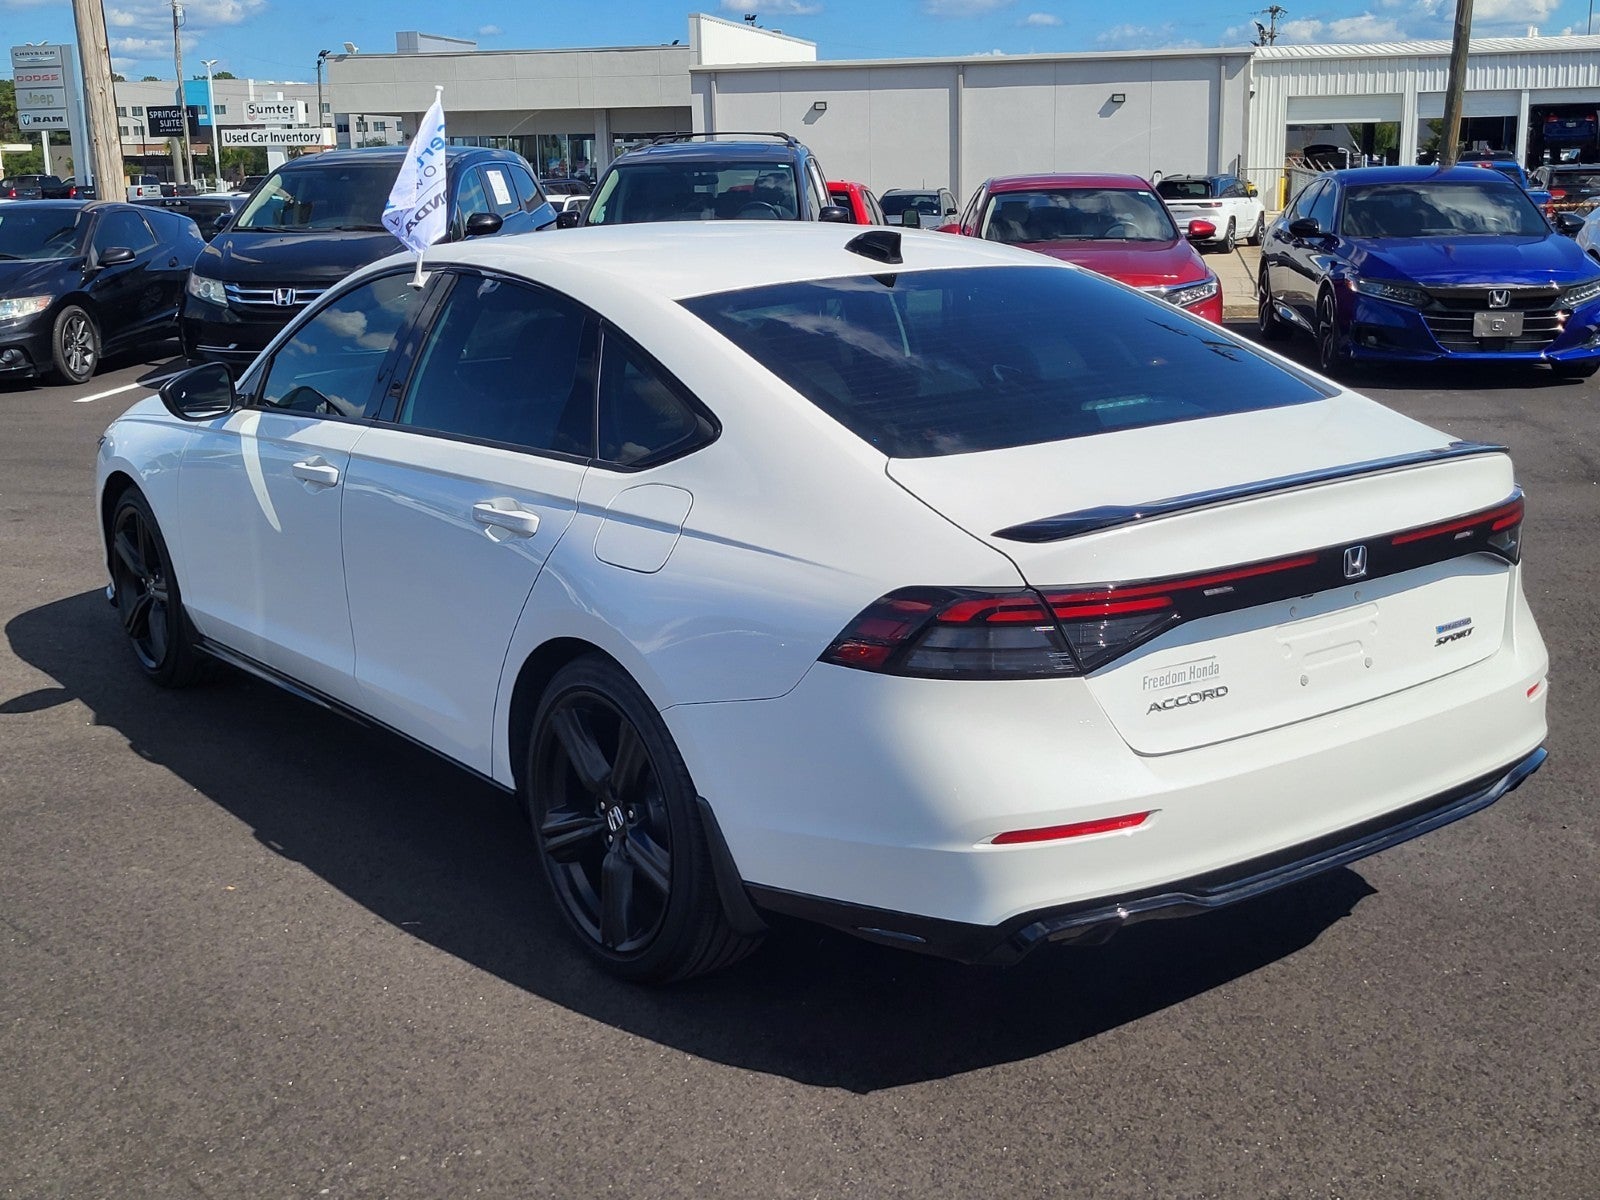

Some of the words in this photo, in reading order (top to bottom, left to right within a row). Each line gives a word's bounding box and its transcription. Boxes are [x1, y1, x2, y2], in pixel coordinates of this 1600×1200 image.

[16, 74, 59, 82] DODGE
[25, 92, 54, 106] Jeep
[248, 104, 294, 114] Sumter
[225, 132, 248, 143] Used
[251, 132, 268, 142] Car
[270, 132, 320, 144] Inventory
[1434, 626, 1475, 647] SPORT
[1142, 670, 1187, 691] Freedom
[1189, 661, 1220, 681] Honda
[1146, 685, 1229, 716] ACCORD
